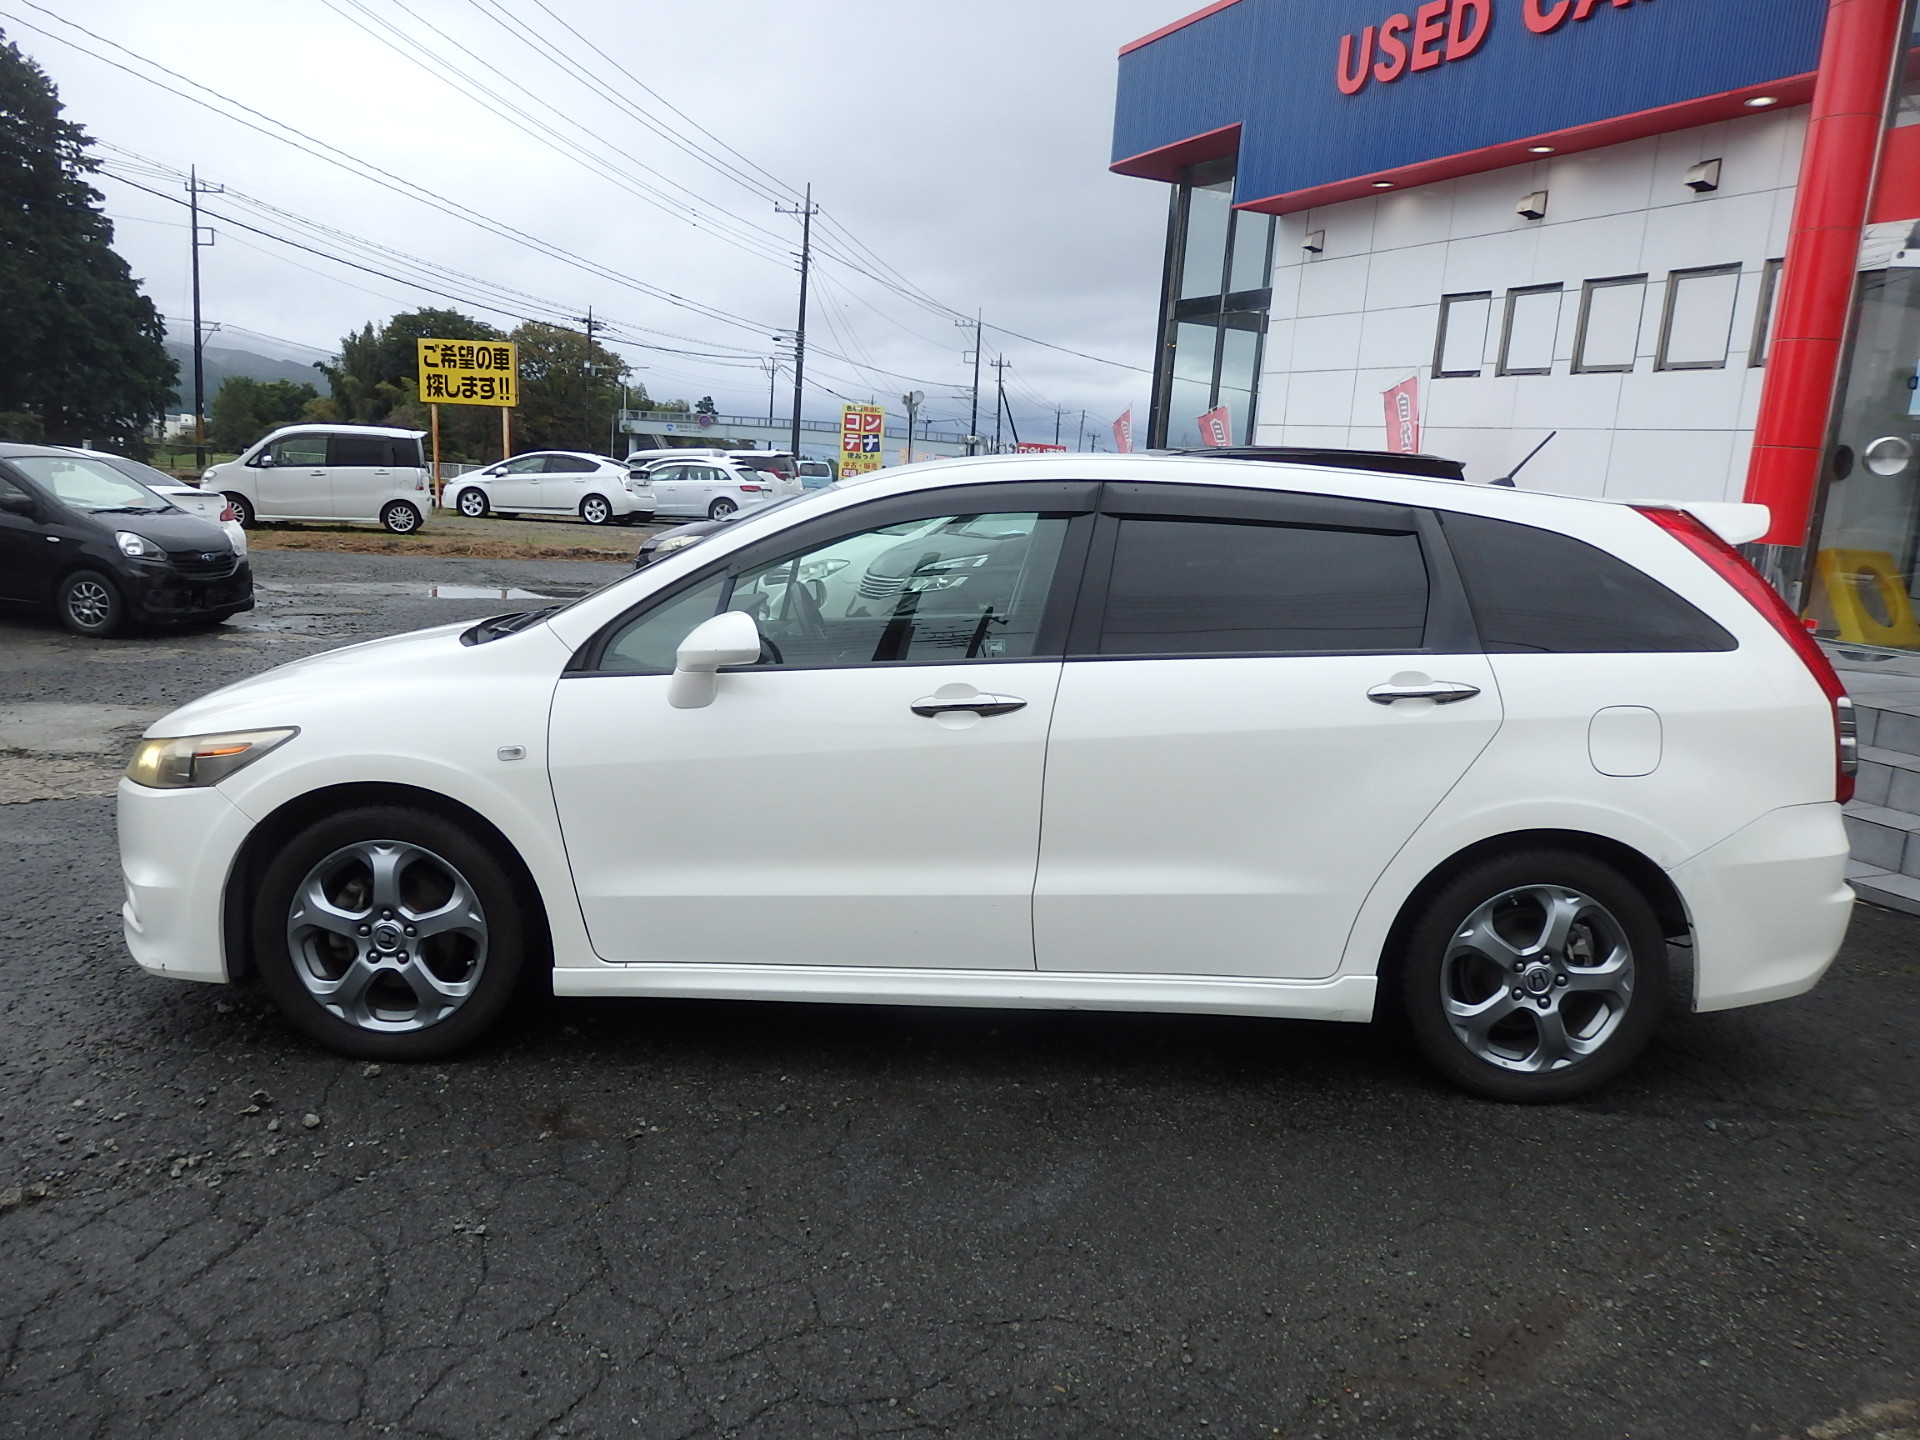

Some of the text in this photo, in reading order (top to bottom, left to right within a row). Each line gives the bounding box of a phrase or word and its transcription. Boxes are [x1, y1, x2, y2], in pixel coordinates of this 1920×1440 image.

[1337, 0, 1490, 94] USED
[423, 344, 510, 371] ご希望の車
[426, 373, 510, 401] 探します!!
